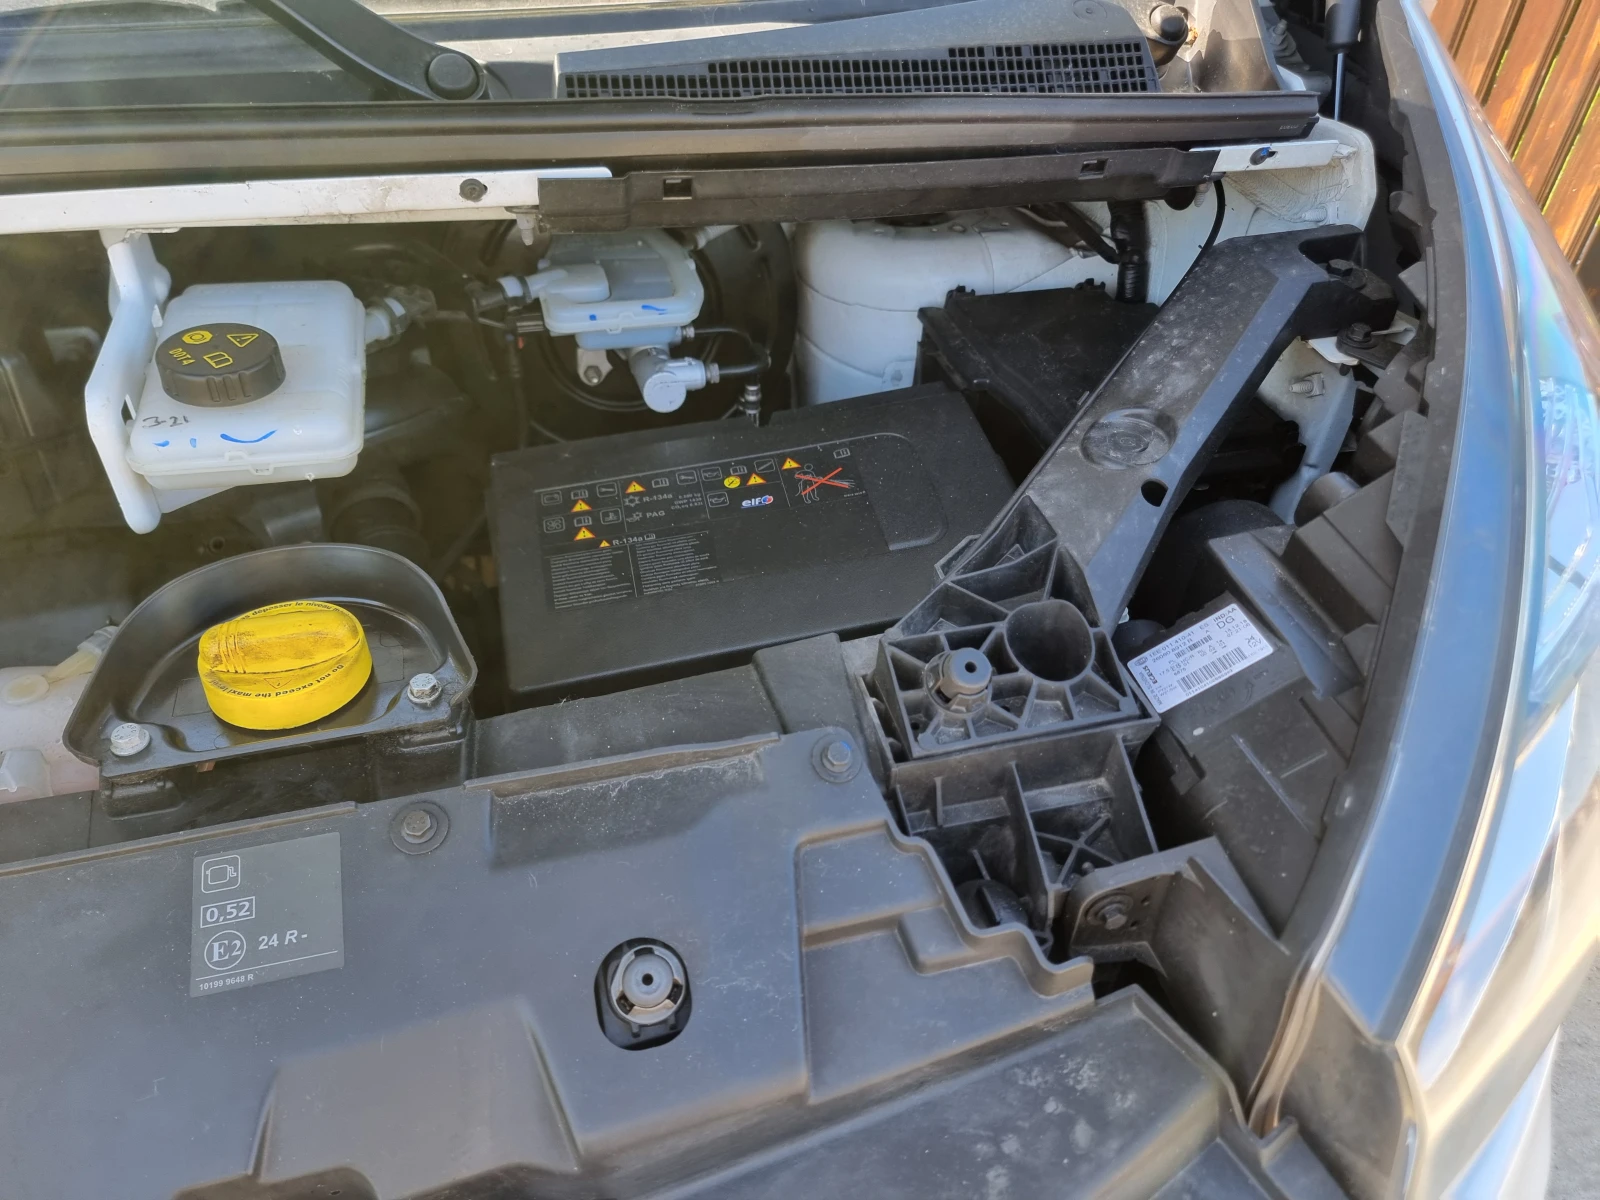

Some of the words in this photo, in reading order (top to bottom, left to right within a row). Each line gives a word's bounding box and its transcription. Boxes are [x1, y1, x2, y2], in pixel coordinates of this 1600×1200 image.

[646, 510, 666, 519] PAG
[612, 536, 643, 546] R-134a
[1216, 615, 1235, 629] DG
[315, 673, 331, 683] not
[229, 688, 252, 697] maxi
[275, 682, 314, 697] exceed
[206, 901, 251, 922] 0,52
[210, 939, 242, 962] E2
[258, 933, 279, 950] 24
[199, 980, 224, 991] 10199
[225, 976, 245, 986] 9648
